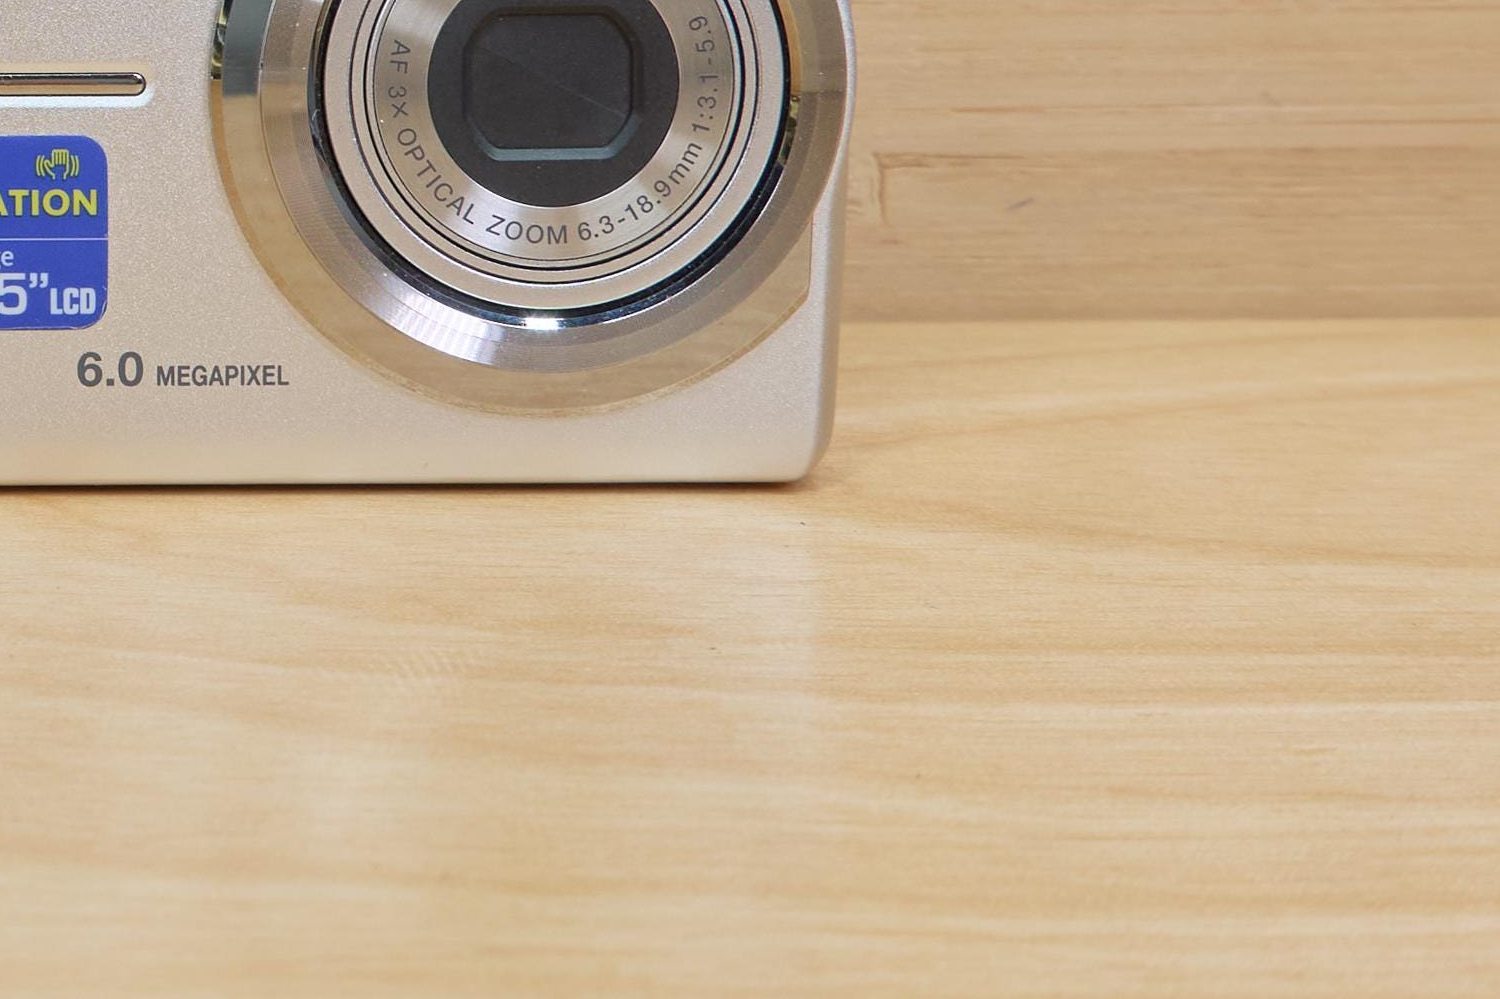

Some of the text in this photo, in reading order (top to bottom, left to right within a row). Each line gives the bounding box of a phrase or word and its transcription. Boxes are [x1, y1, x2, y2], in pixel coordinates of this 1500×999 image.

[389, 39, 411, 75] AF
[396, 127, 476, 226] OPTICAL
[485, 214, 569, 245] ZOOM
[50, 287, 97, 315] LCD
[76, 351, 290, 387] 6.0 MEGAPIXEL
